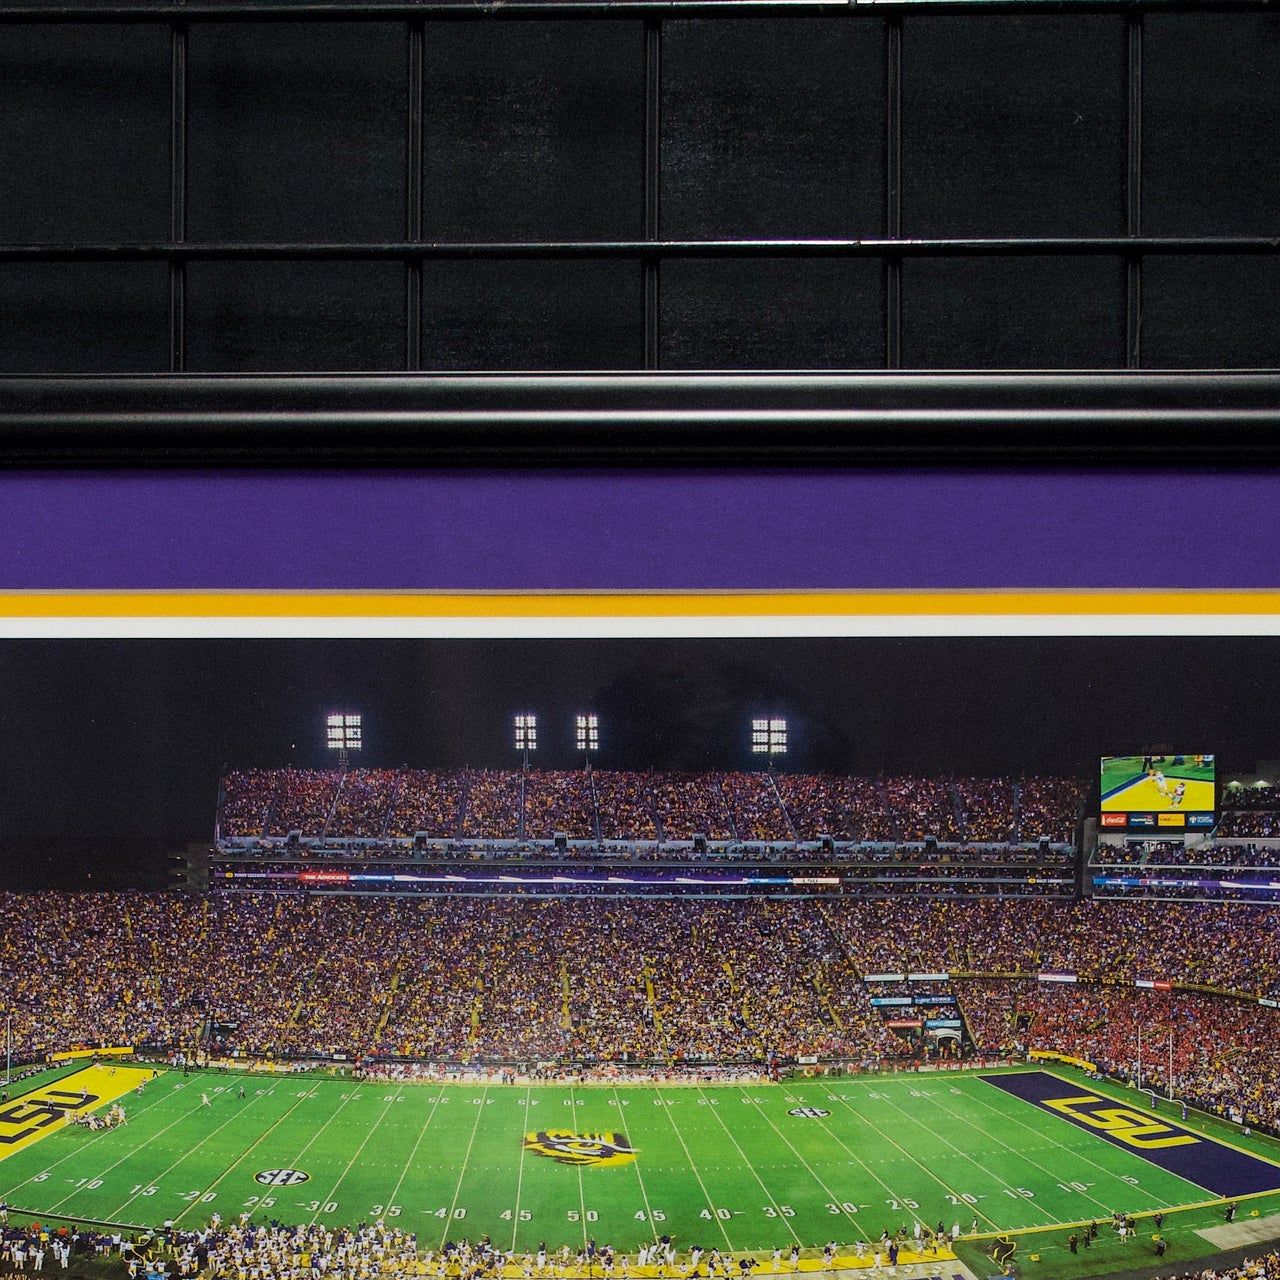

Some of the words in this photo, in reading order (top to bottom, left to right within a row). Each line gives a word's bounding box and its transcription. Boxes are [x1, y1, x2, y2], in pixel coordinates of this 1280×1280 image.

[789, 1108, 830, 1118] SEC
[1039, 1095, 1203, 1150] LSU
[34, 1172, 53, 1184] 5
[75, 1178, 104, 1191] 10
[256, 1170, 308, 1186] SEC
[1121, 1174, 1140, 1185] 5
[130, 1184, 160, 1197] 15
[1003, 1187, 1036, 1200] 15
[1057, 1181, 1089, 1194] 10
[183, 1188, 217, 1204] 20
[243, 1196, 278, 1209] 25
[944, 1193, 979, 1205] 20
[305, 1200, 339, 1214] 30
[825, 1202, 859, 1215] 30
[885, 1198, 920, 1211] 25
[369, 1205, 403, 1218] 35
[432, 1208, 467, 1220] 40
[500, 1209, 532, 1221] 45
[566, 1210, 600, 1222] 50
[633, 1210, 667, 1222] 45
[699, 1208, 733, 1220] 40
[762, 1206, 798, 1218] 35
